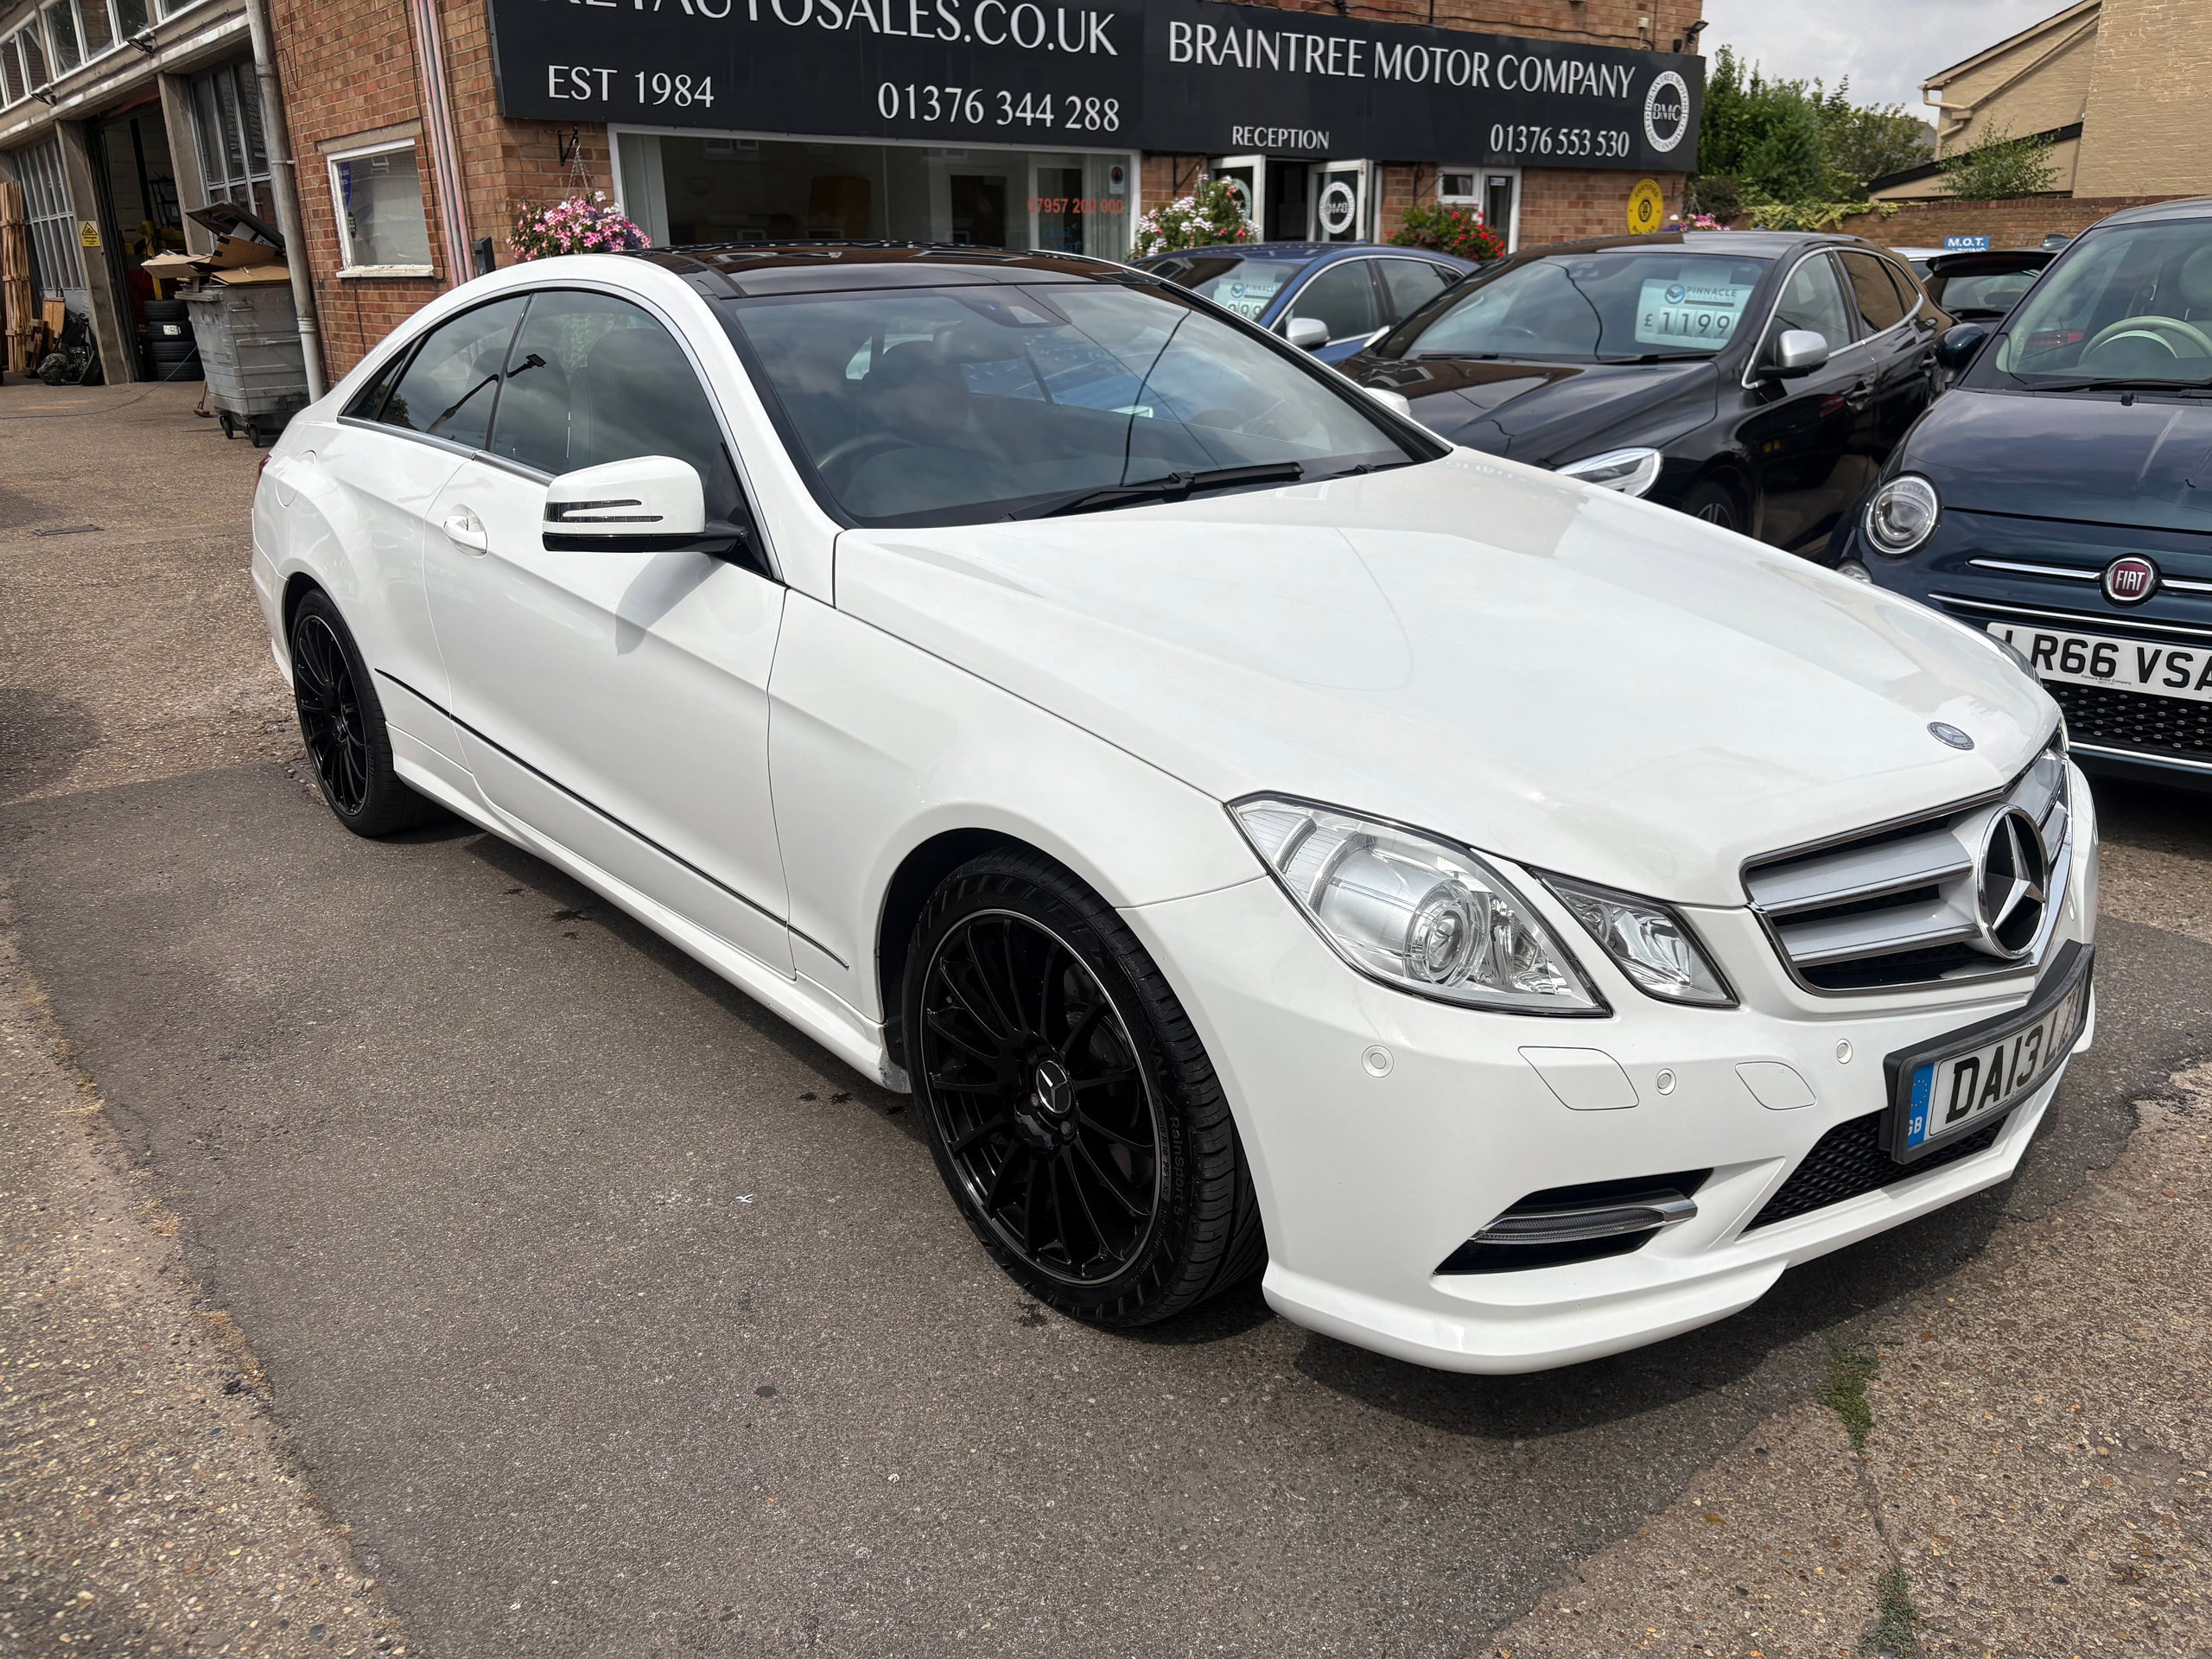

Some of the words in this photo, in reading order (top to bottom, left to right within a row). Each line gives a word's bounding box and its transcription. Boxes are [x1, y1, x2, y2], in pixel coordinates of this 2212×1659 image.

[1169, 21, 1367, 78] BRAINTREE
[1374, 41, 1491, 88] MOTOR
[1497, 54, 1637, 99] COMPANY
[549, 65, 618, 101] EST
[635, 71, 715, 108] 1984
[877, 82, 985, 124] 01376
[995, 90, 1055, 127] 344
[1065, 96, 1120, 131] 288
[1652, 103, 1681, 122] BMC
[1232, 126, 1330, 150] RECEPTION
[1490, 124, 1553, 155] 01376
[1556, 128, 1592, 156] 553
[1595, 130, 1630, 157] 530
[1027, 197, 1069, 214] 07957
[1072, 198, 1097, 214] 200
[1948, 237, 1985, 247] M.O.T.
[1686, 286, 1738, 297] PINNACLE
[2114, 569, 2145, 591] FIAT
[1945, 1024, 2044, 1124] DA13
[1169, 1116, 1185, 1202] RainSport
